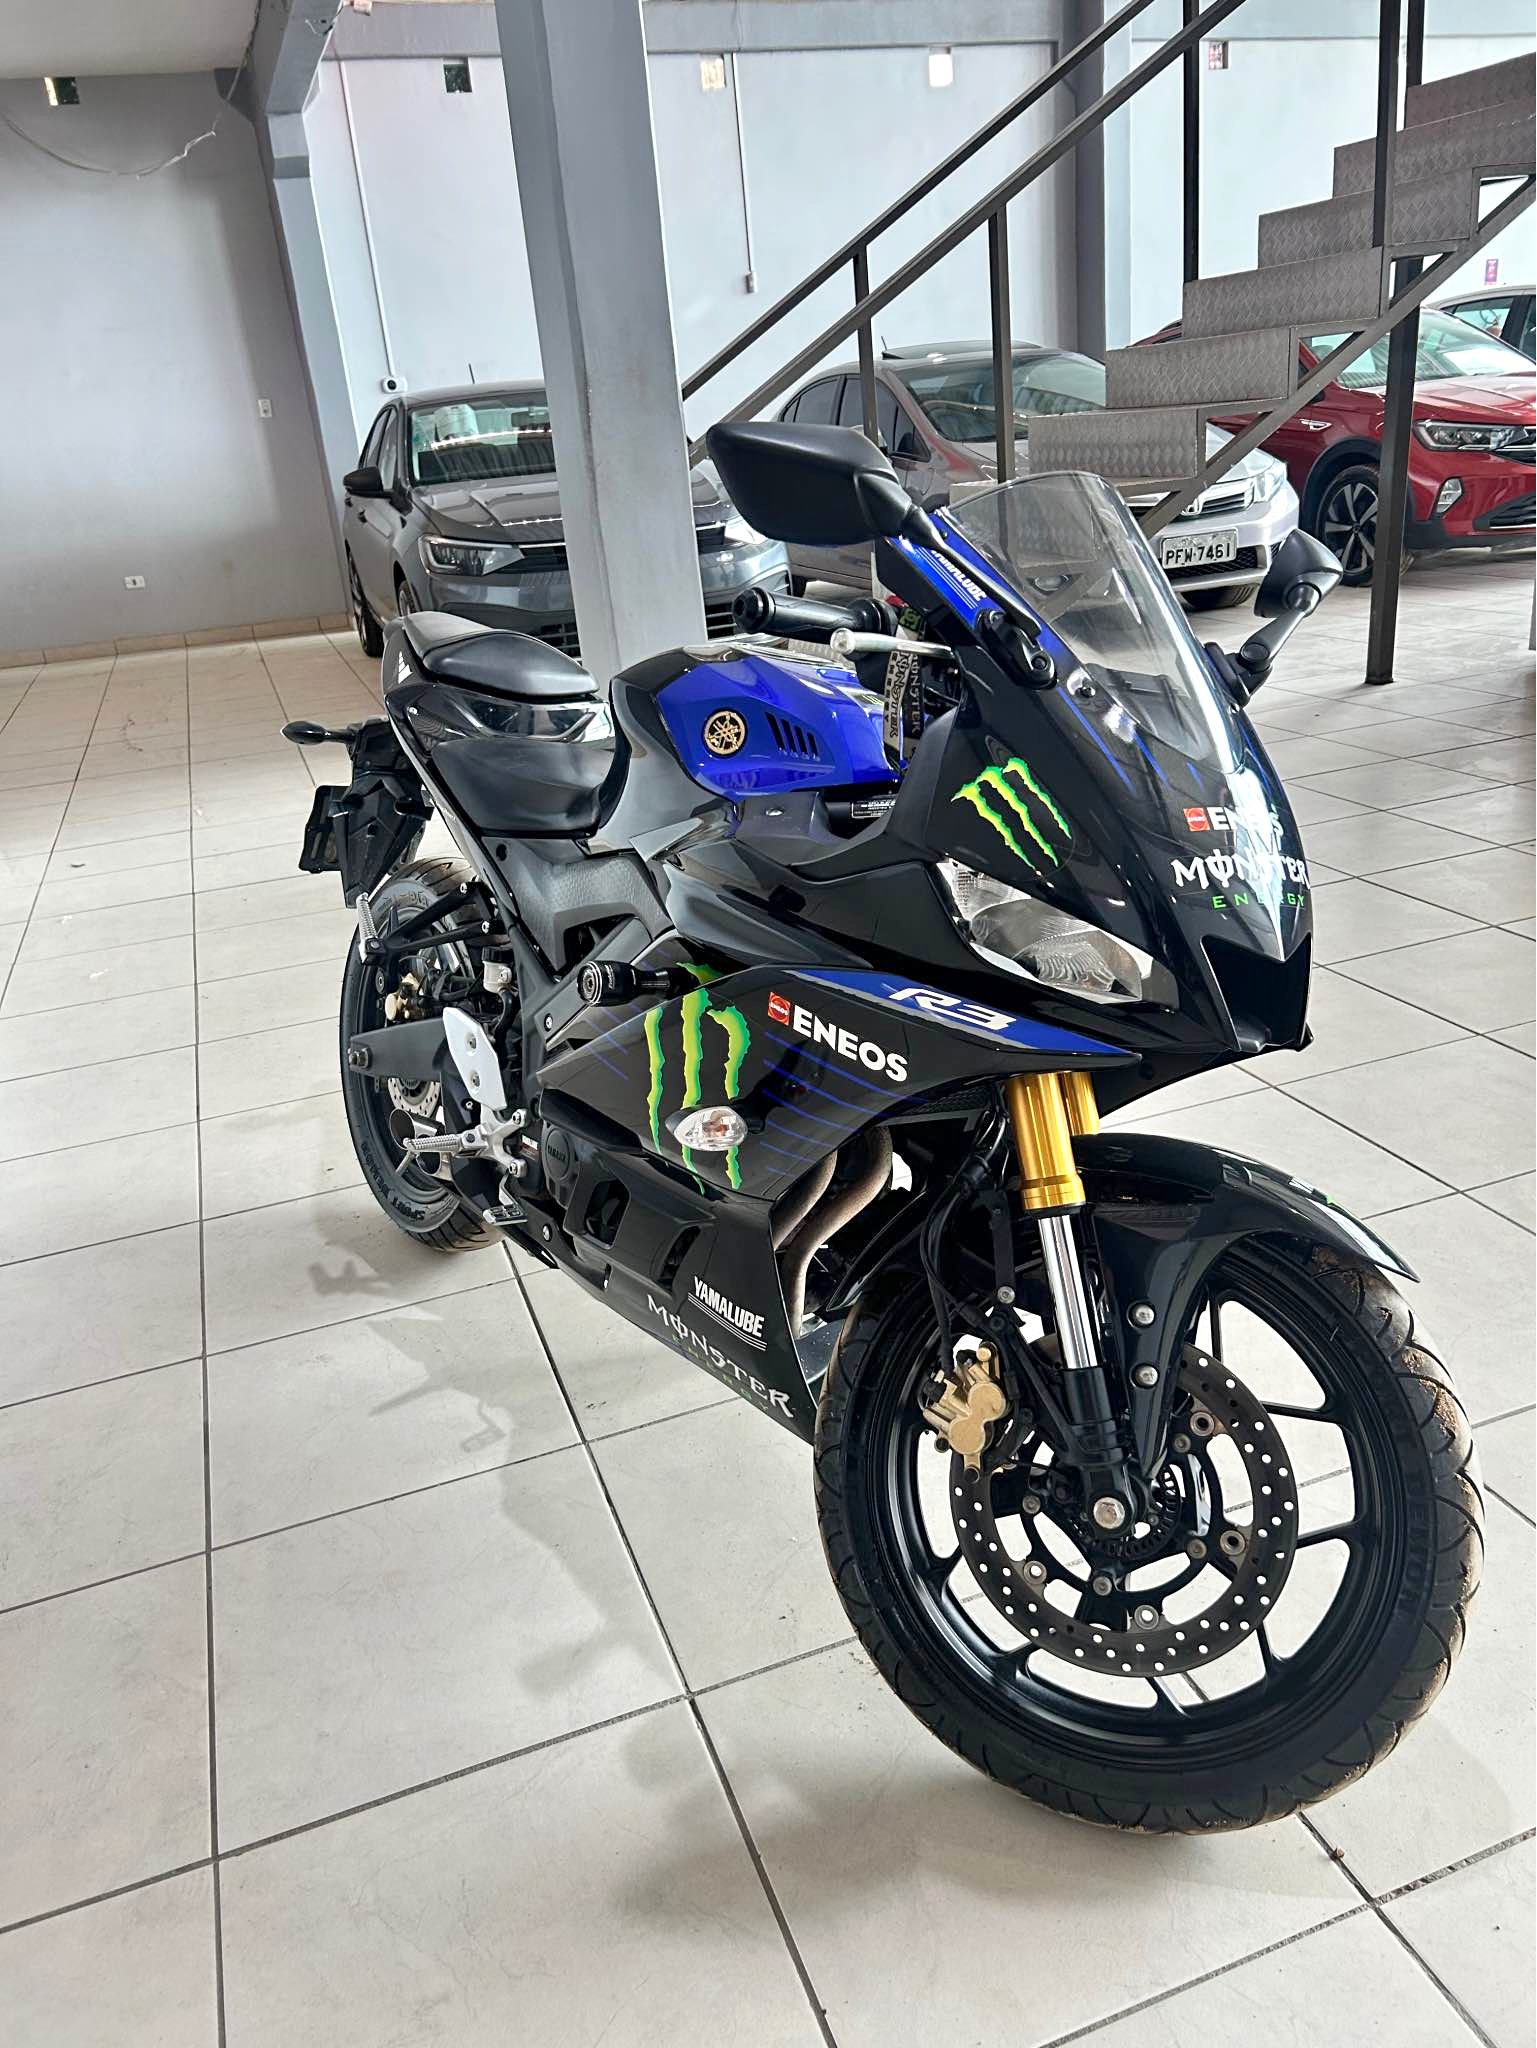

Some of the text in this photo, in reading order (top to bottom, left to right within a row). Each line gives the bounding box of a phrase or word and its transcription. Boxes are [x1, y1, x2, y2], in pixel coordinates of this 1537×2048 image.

[1170, 849, 1311, 890] MONTER
[889, 987, 1017, 1031] R3
[792, 1004, 908, 1082] ENEOS
[694, 1275, 765, 1337] YAMALUBE
[646, 1294, 794, 1418] MONSTER
